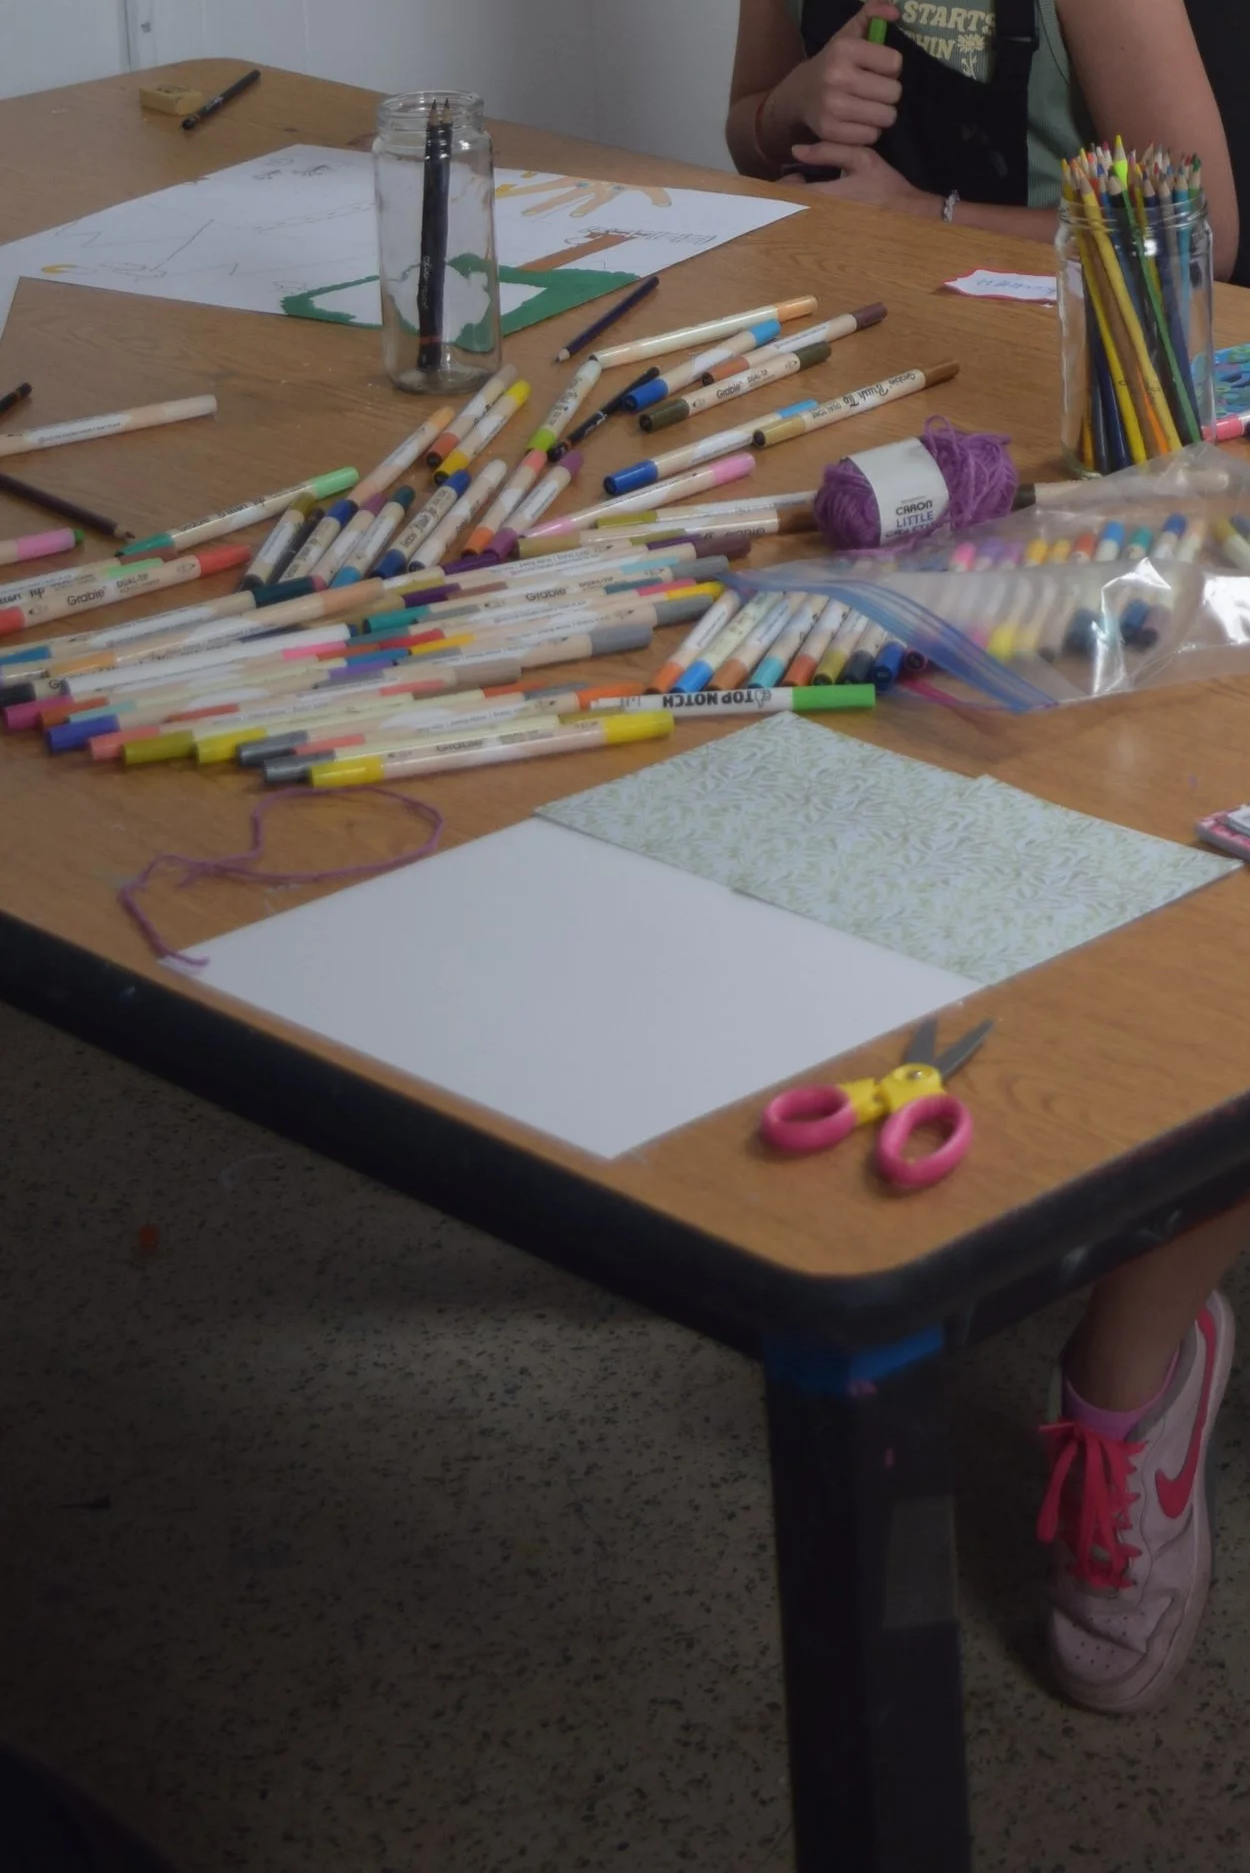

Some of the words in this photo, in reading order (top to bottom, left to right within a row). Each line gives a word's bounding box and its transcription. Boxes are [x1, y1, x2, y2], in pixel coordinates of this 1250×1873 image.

[896, 510, 935, 528] LITTLE
[662, 692, 719, 708] NOTCH
[721, 689, 755, 705] TOP
